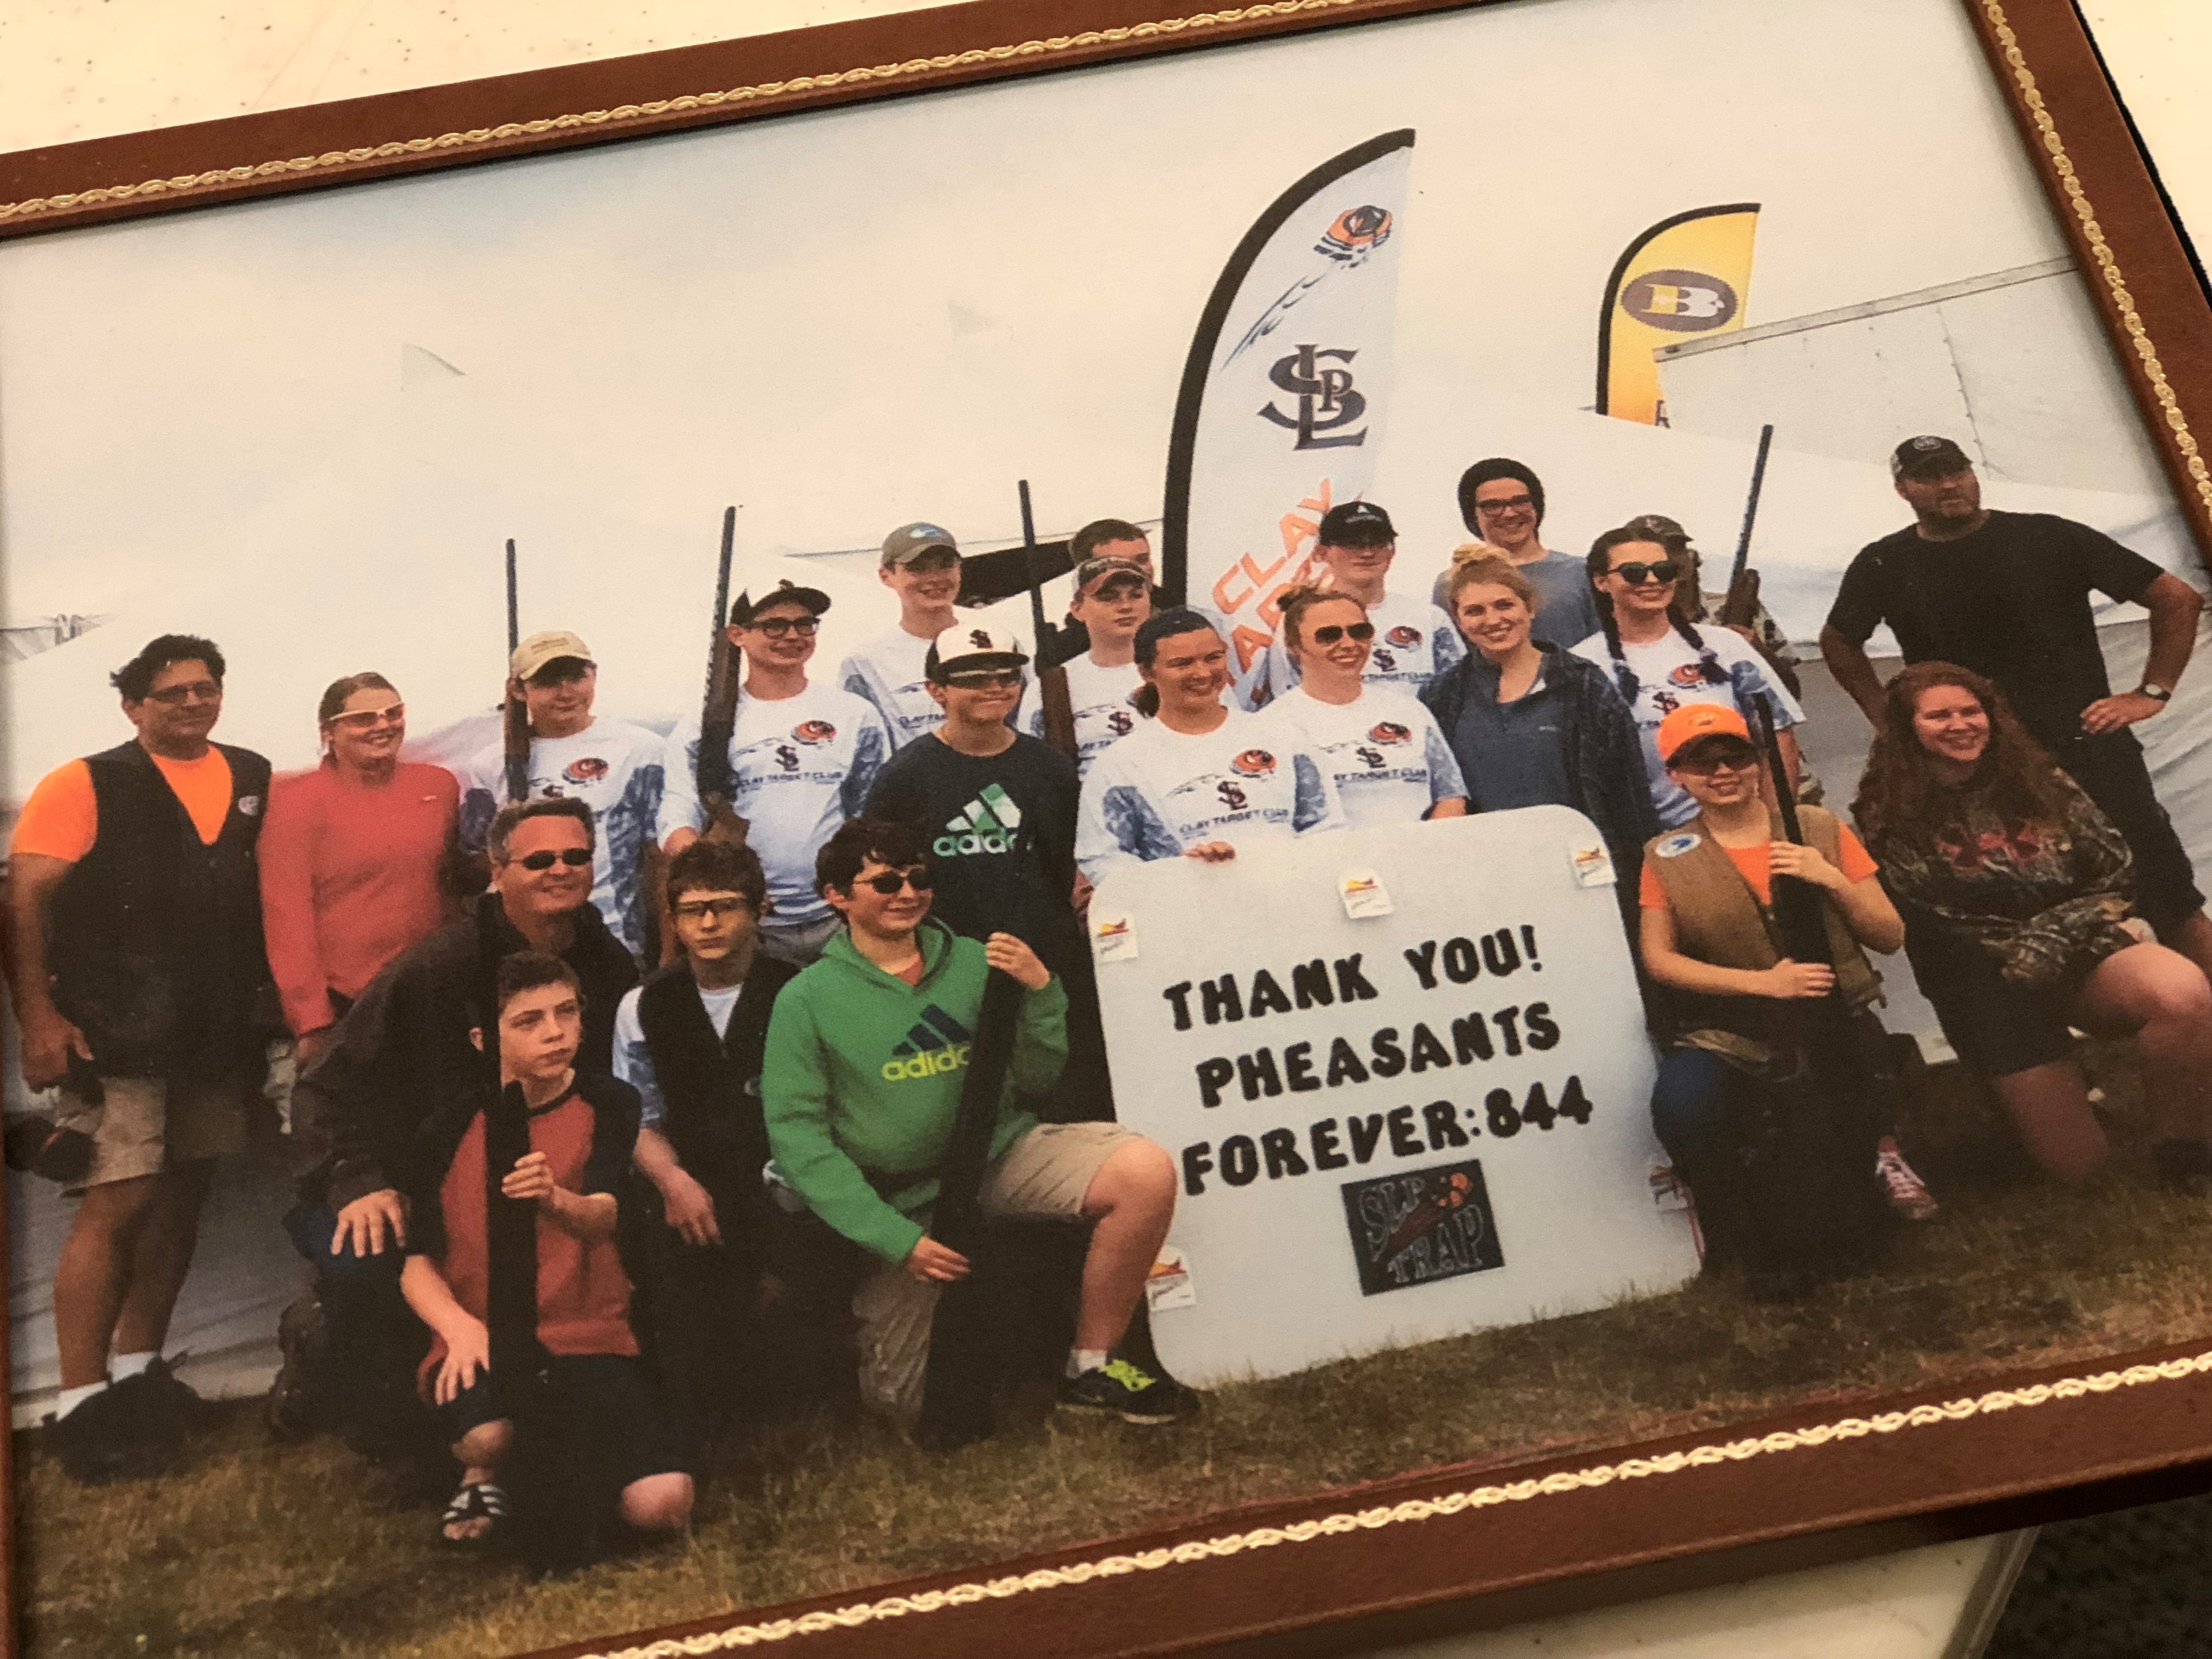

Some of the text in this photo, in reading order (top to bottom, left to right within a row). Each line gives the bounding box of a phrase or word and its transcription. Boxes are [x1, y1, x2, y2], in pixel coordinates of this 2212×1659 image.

[1212, 478, 1330, 614] CLAY
[1163, 924, 1542, 1031] THANK YOU!
[1196, 1002, 1560, 1108] PHEASANTS
